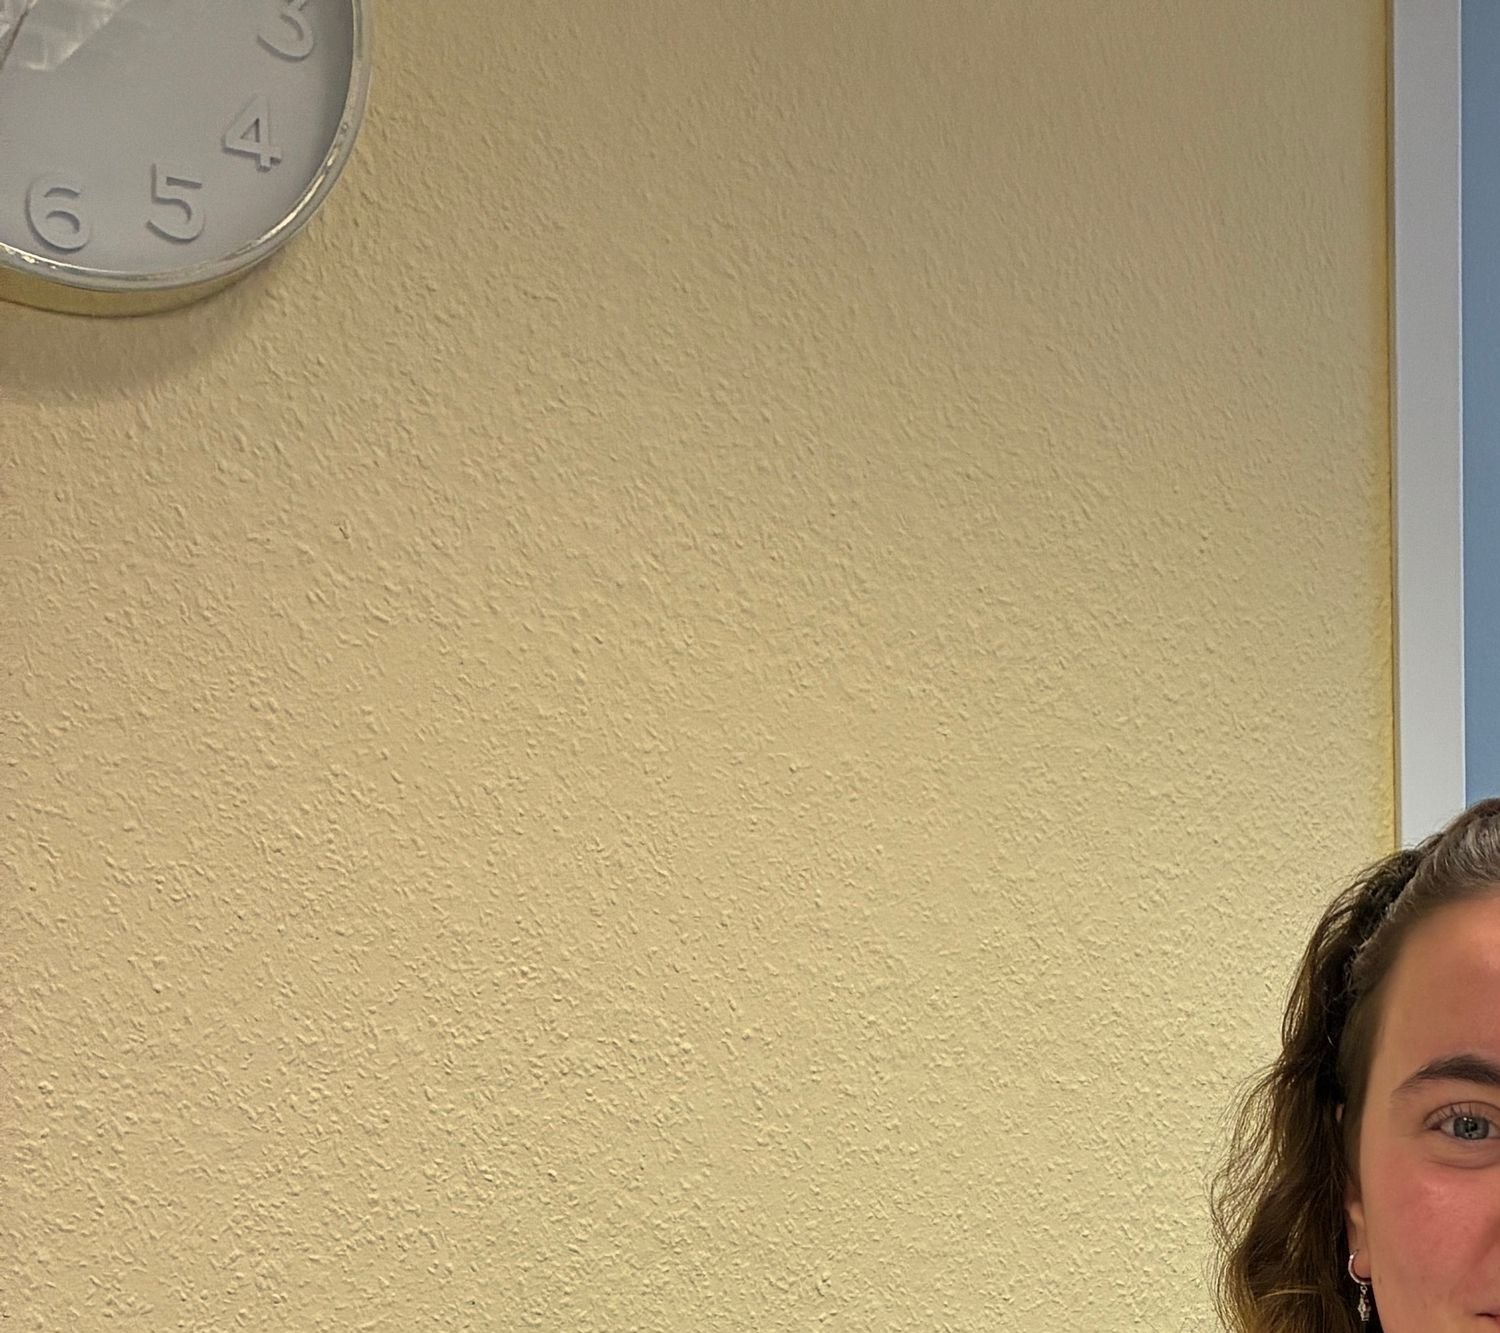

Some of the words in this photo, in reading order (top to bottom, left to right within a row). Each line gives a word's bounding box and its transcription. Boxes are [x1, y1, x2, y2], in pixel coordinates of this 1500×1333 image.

[220, 98, 283, 173] 4
[25, 172, 93, 251] 6
[146, 160, 207, 243] 5
